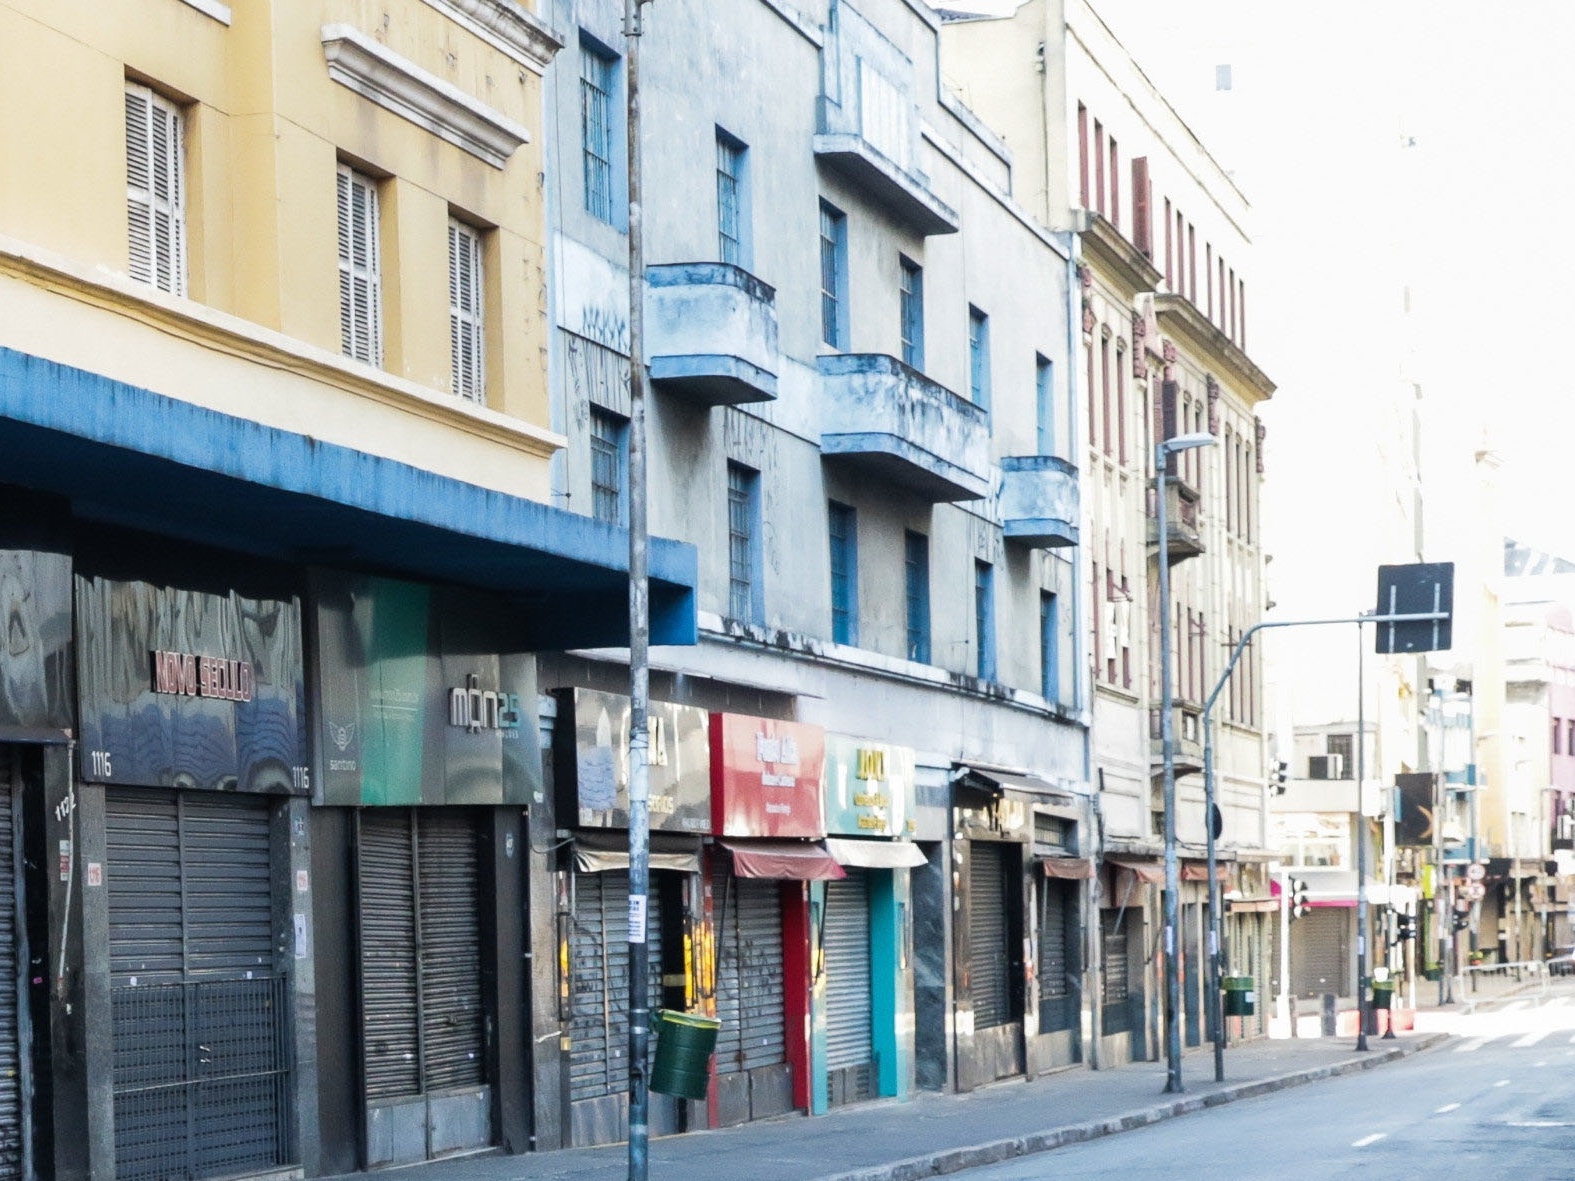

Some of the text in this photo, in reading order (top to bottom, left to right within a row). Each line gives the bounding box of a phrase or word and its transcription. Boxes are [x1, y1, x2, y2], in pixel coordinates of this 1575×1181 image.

[155, 649, 197, 696] NOVO
[91, 750, 112, 777] 1116
[292, 766, 310, 789] 1116
